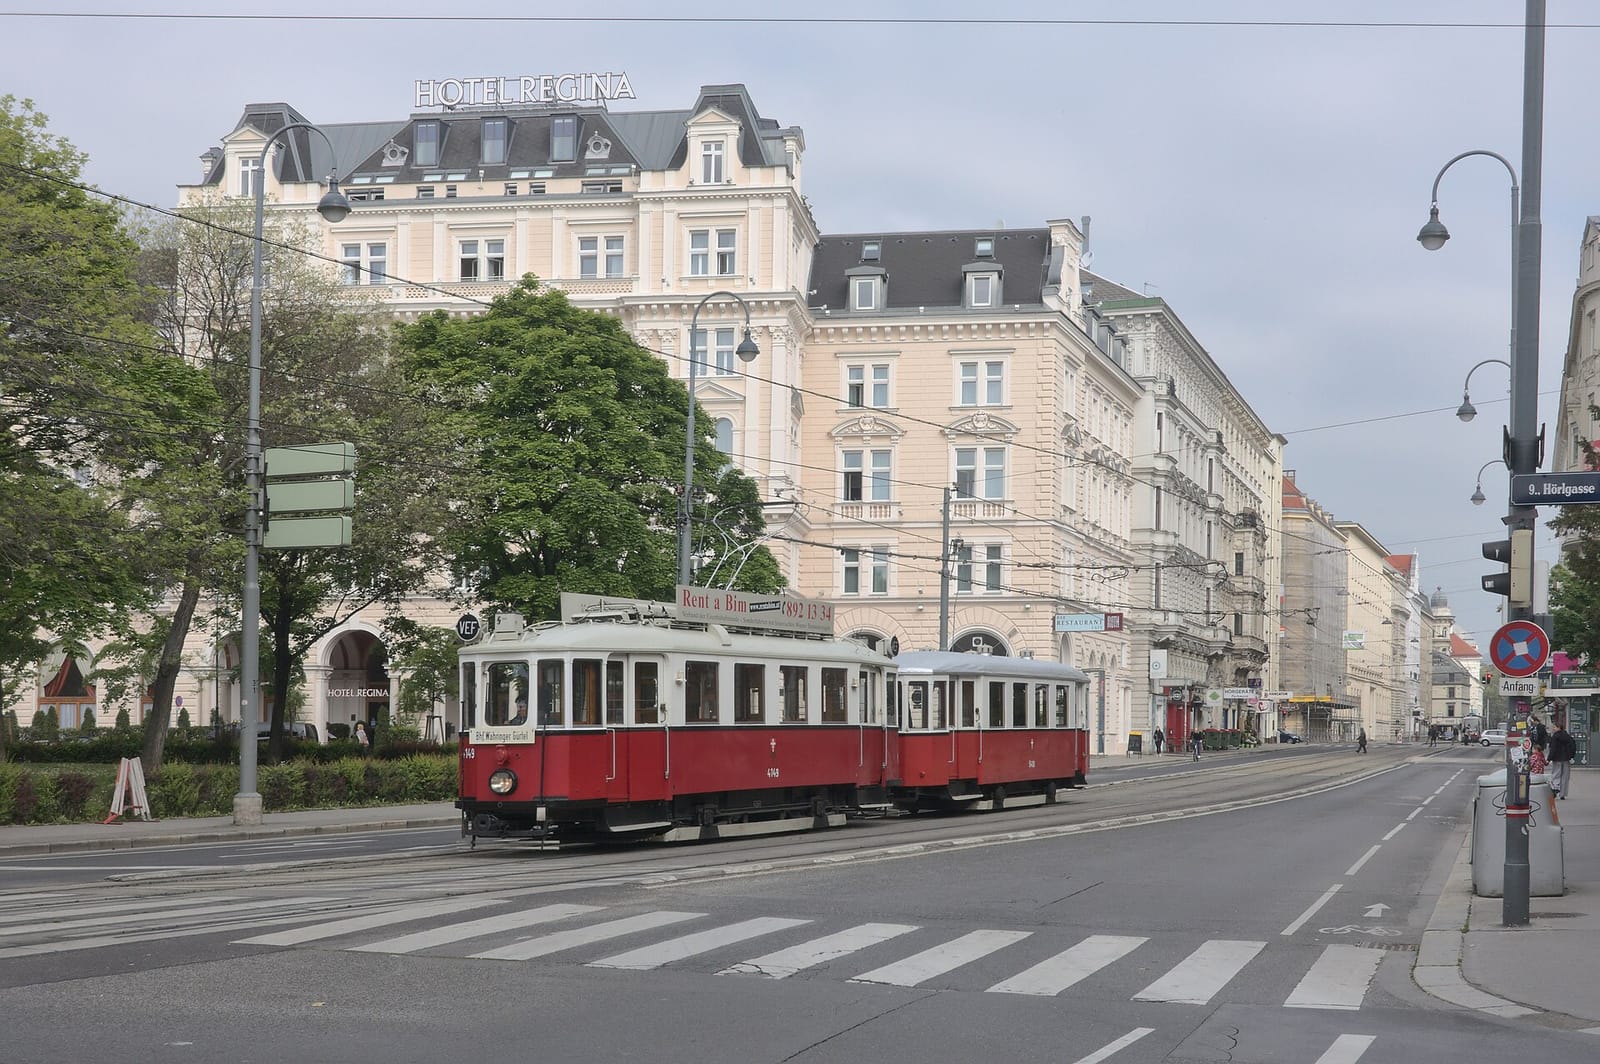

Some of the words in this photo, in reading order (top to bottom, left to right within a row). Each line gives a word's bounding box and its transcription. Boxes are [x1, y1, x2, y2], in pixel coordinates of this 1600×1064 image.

[415, 78, 514, 107] HOTEL
[519, 72, 636, 103] REGINA
[1542, 482, 1596, 497] Hörlgasse
[683, 589, 709, 608] Rent
[714, 599, 720, 610] a
[725, 594, 747, 613] Bim
[786, 601, 804, 618] 892
[807, 603, 817, 620] 13
[820, 605, 831, 621] 34
[459, 620, 478, 635] VEF
[327, 688, 355, 697] HOTEL
[356, 688, 389, 697] REGINA
[1503, 681, 1534, 693] Anfang
